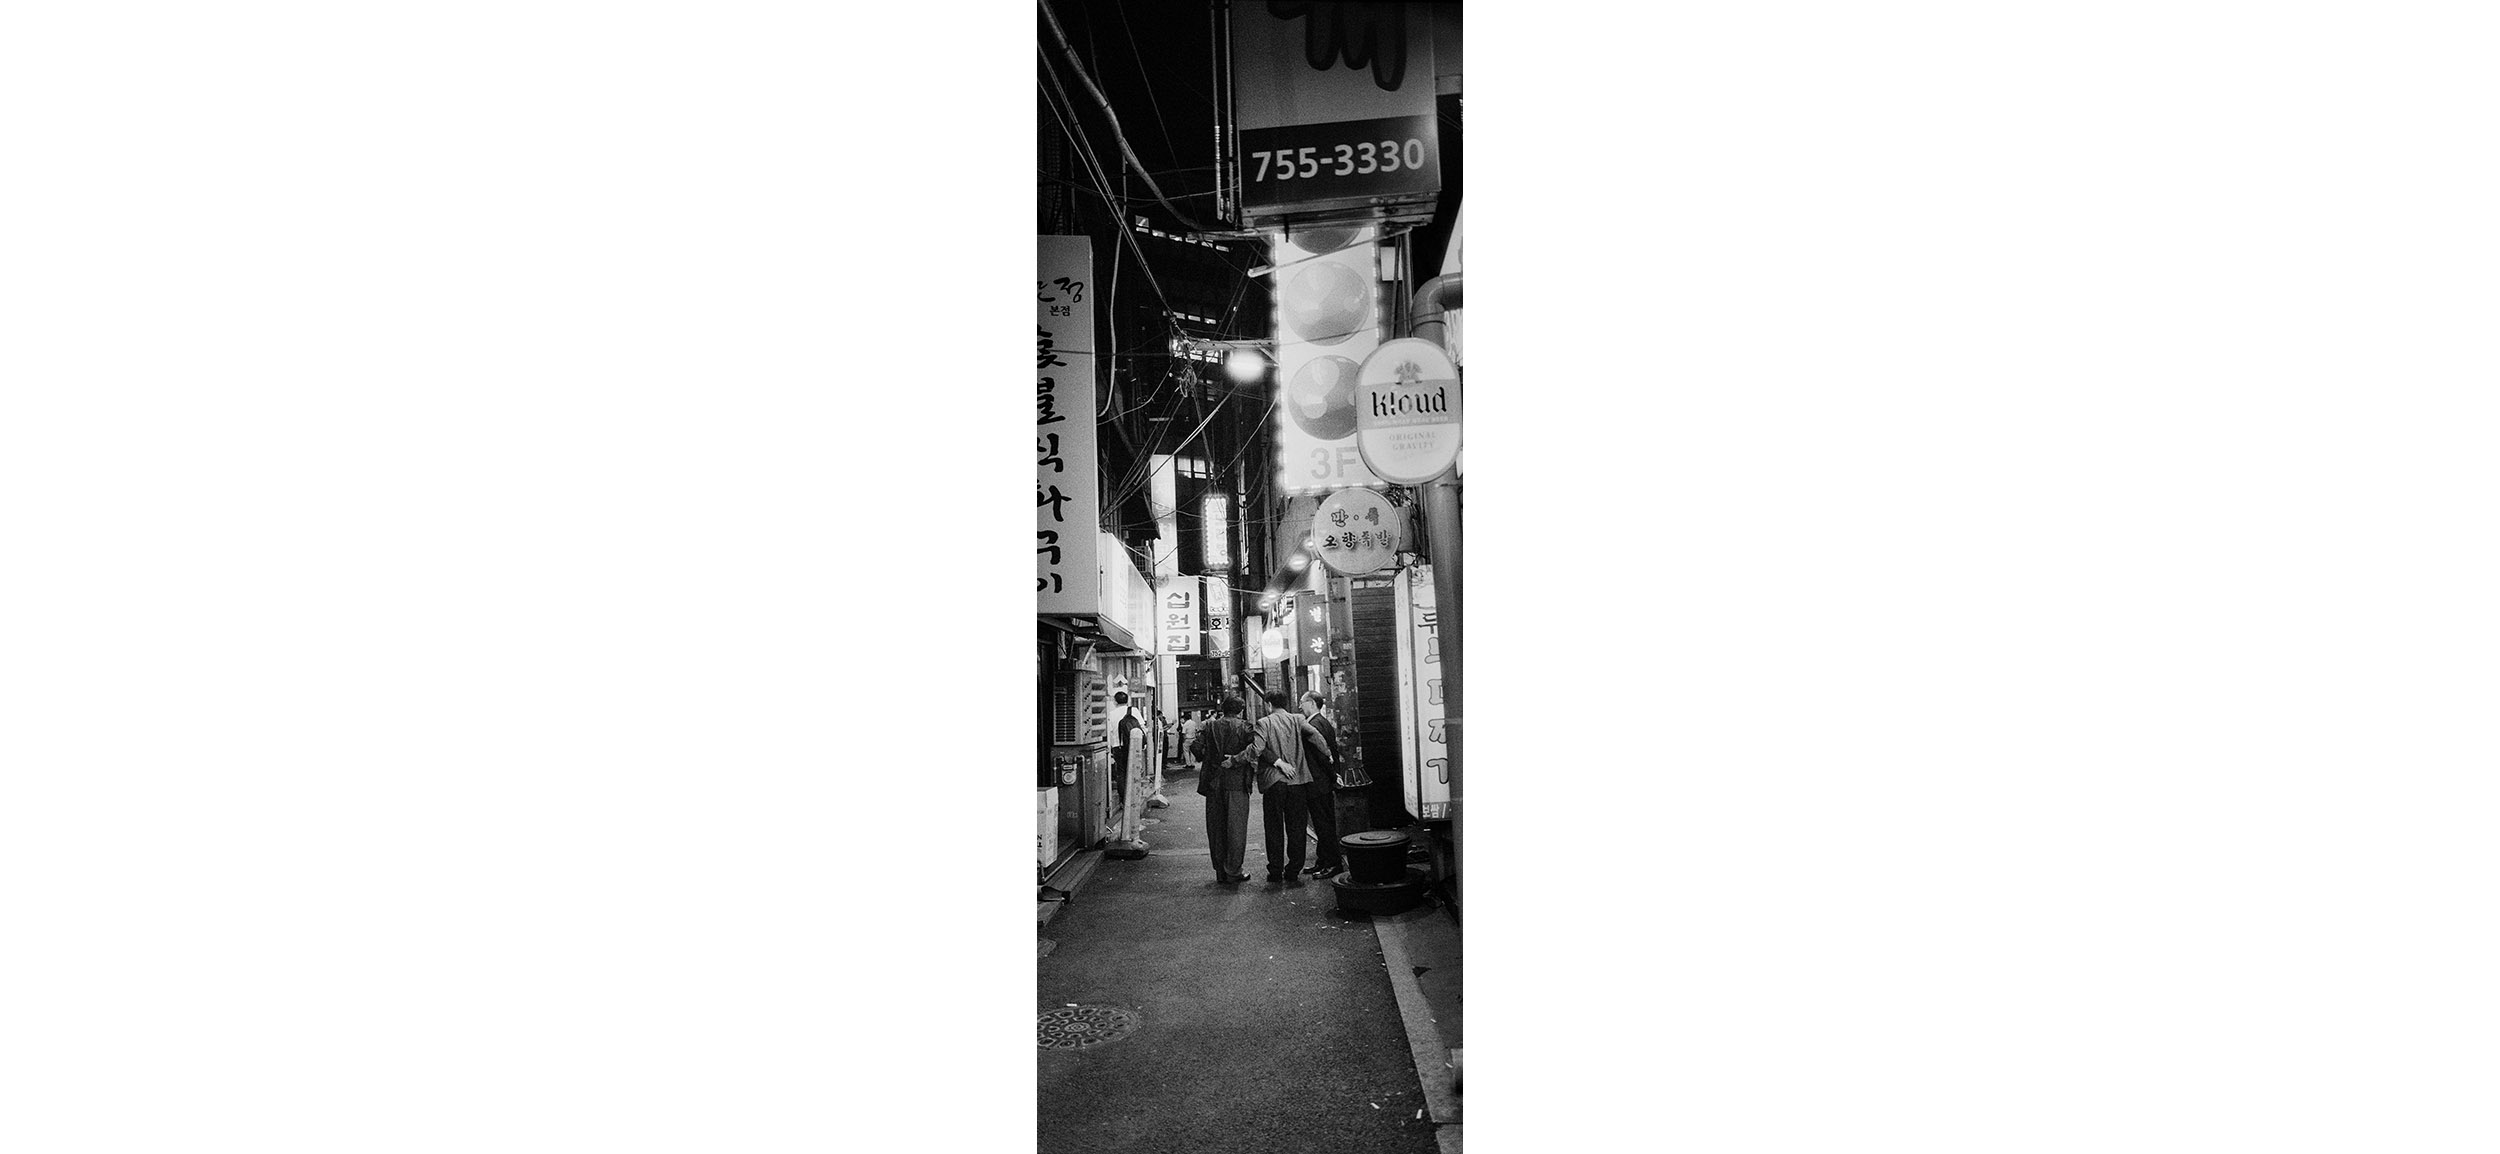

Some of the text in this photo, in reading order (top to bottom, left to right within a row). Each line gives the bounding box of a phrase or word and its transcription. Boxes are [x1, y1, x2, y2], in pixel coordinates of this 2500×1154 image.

[1252, 138, 1424, 183] 755-3330
[1050, 305, 1071, 317] 본점
[1389, 431, 1437, 441] ORIGINAL
[1310, 446, 1358, 480] 3F
[1322, 529, 1392, 551] 오향족발
[1166, 591, 1191, 651] 십원집
